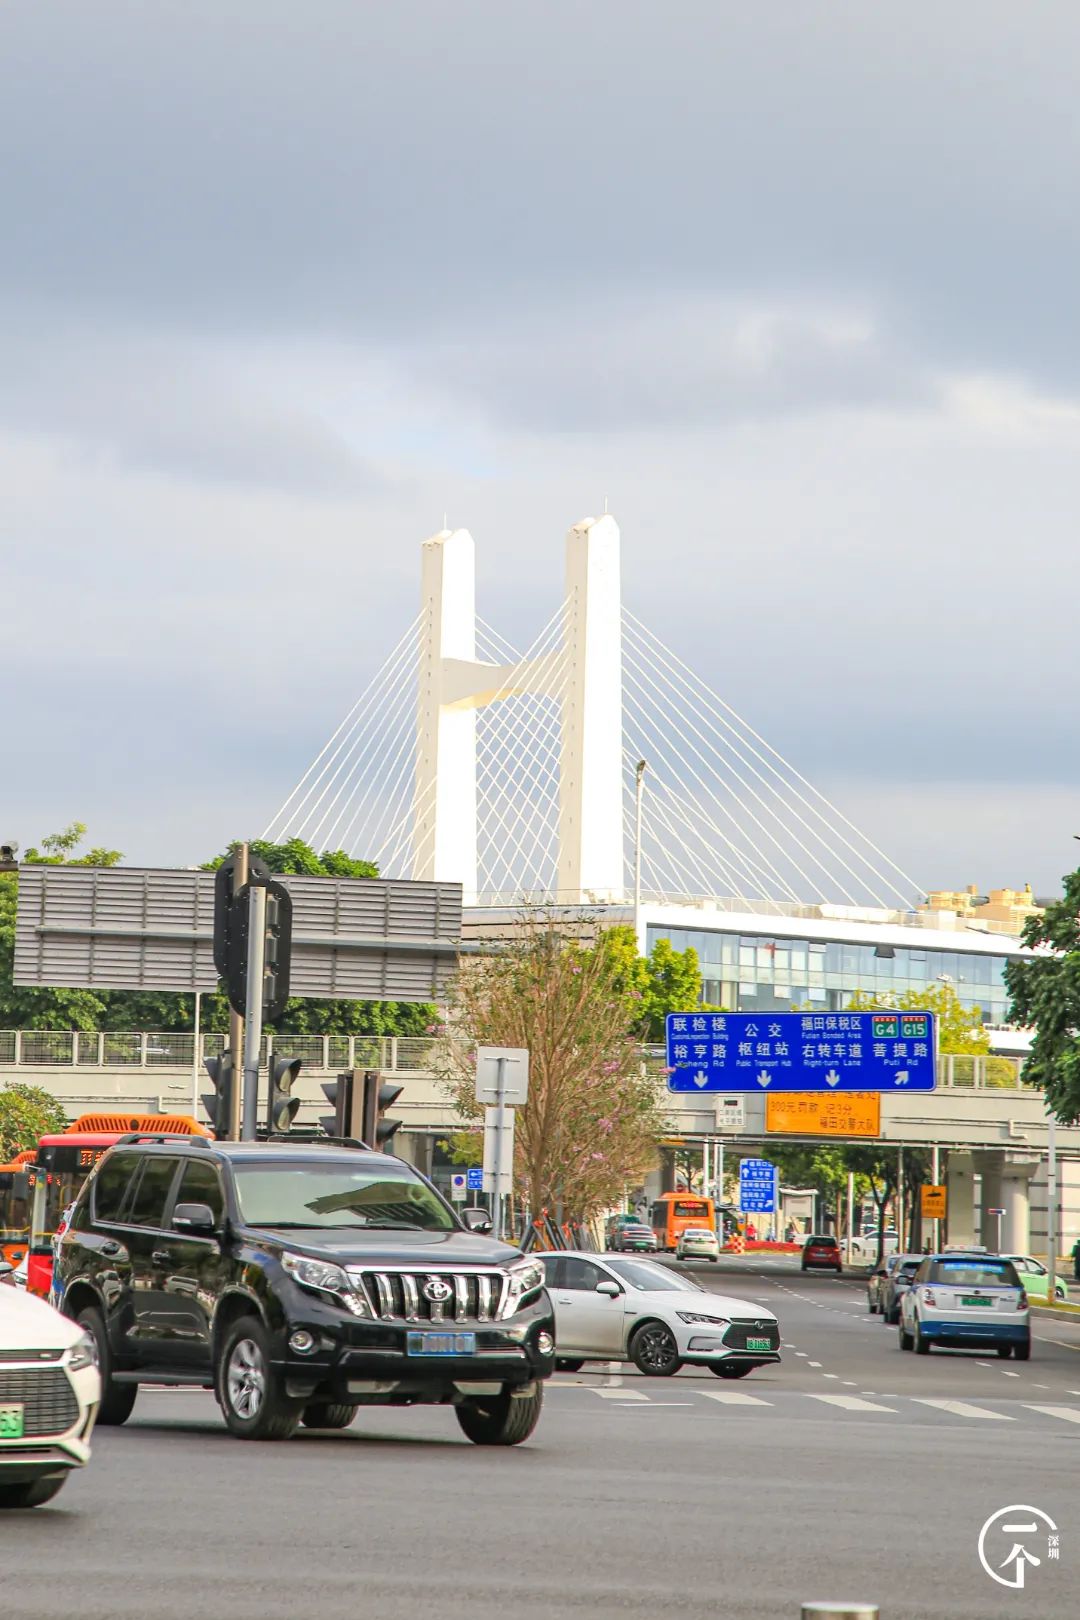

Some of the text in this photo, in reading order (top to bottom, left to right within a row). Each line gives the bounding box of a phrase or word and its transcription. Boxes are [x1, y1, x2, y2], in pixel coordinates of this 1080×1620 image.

[672, 1017, 727, 1031] 联检楼
[744, 1023, 782, 1037] 公交
[801, 1016, 862, 1030] 福田保税区
[876, 1024, 895, 1035] G4
[903, 1023, 925, 1035] G15
[674, 1044, 727, 1058] 裕亨路
[738, 1042, 789, 1056] 枢纽站
[802, 1043, 863, 1058] 右转车道
[873, 1043, 928, 1057] 菩提路
[754, 1060, 779, 1068] Transport
[803, 1059, 839, 1067] Right-turn
[883, 1058, 918, 1066] Puti Rd
[819, 1116, 875, 1131] 福田交警大队
